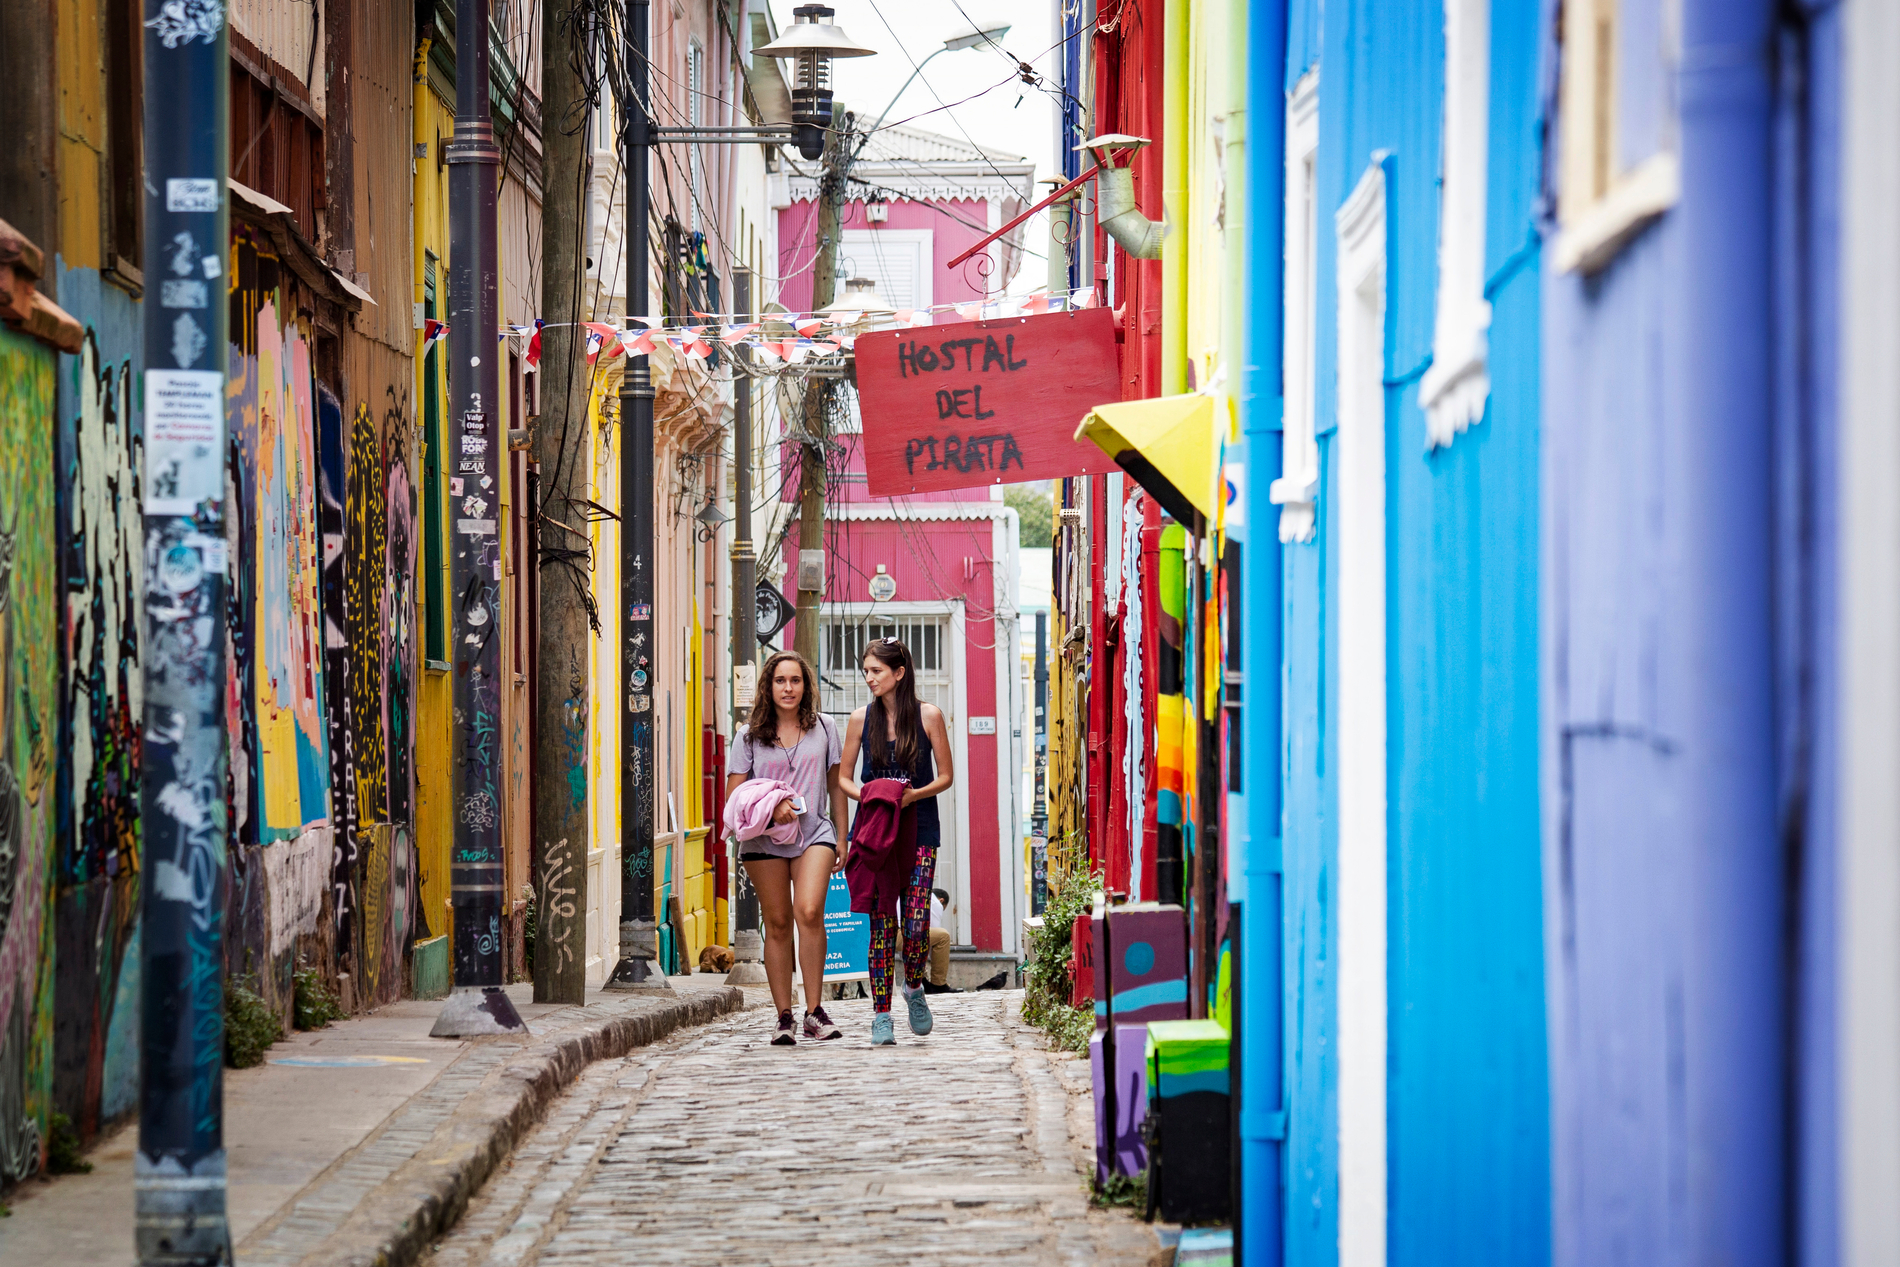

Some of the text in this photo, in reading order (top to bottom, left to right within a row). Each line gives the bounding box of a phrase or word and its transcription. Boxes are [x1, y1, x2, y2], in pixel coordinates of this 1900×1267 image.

[898, 334, 1027, 378] HOSTAL
[936, 385, 995, 420] DEL
[905, 433, 1024, 475] PIRATA
[824, 911, 851, 920] ACIONES
